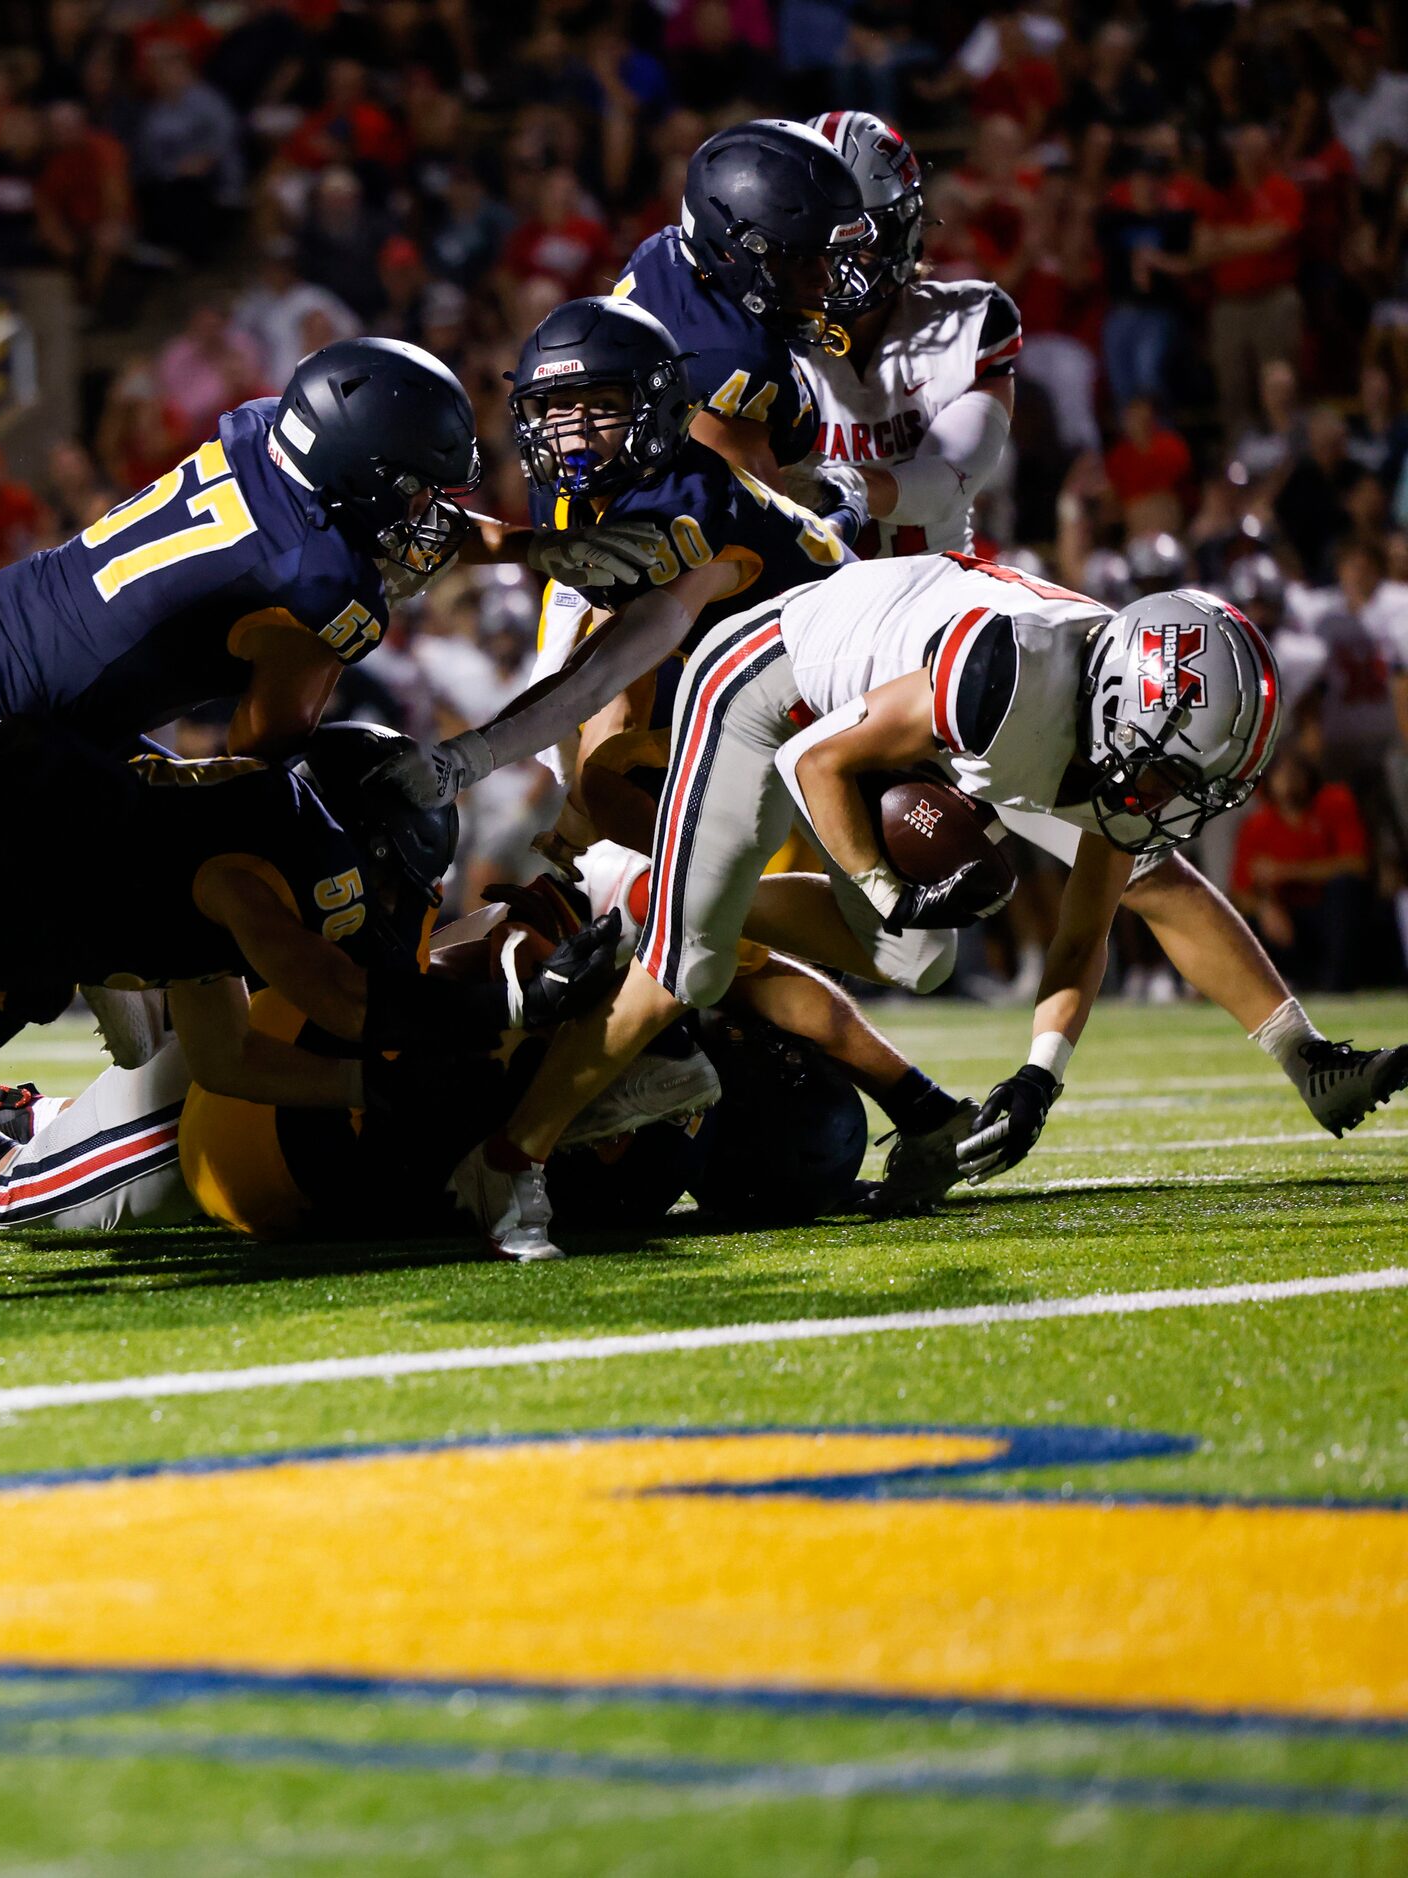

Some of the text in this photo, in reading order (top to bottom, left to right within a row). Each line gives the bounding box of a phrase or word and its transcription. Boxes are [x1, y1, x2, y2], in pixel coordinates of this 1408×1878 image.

[537, 361, 579, 377] Riddell
[708, 368, 779, 422] 44
[81, 438, 259, 604] 57
[1163, 625, 1179, 709] marcus
